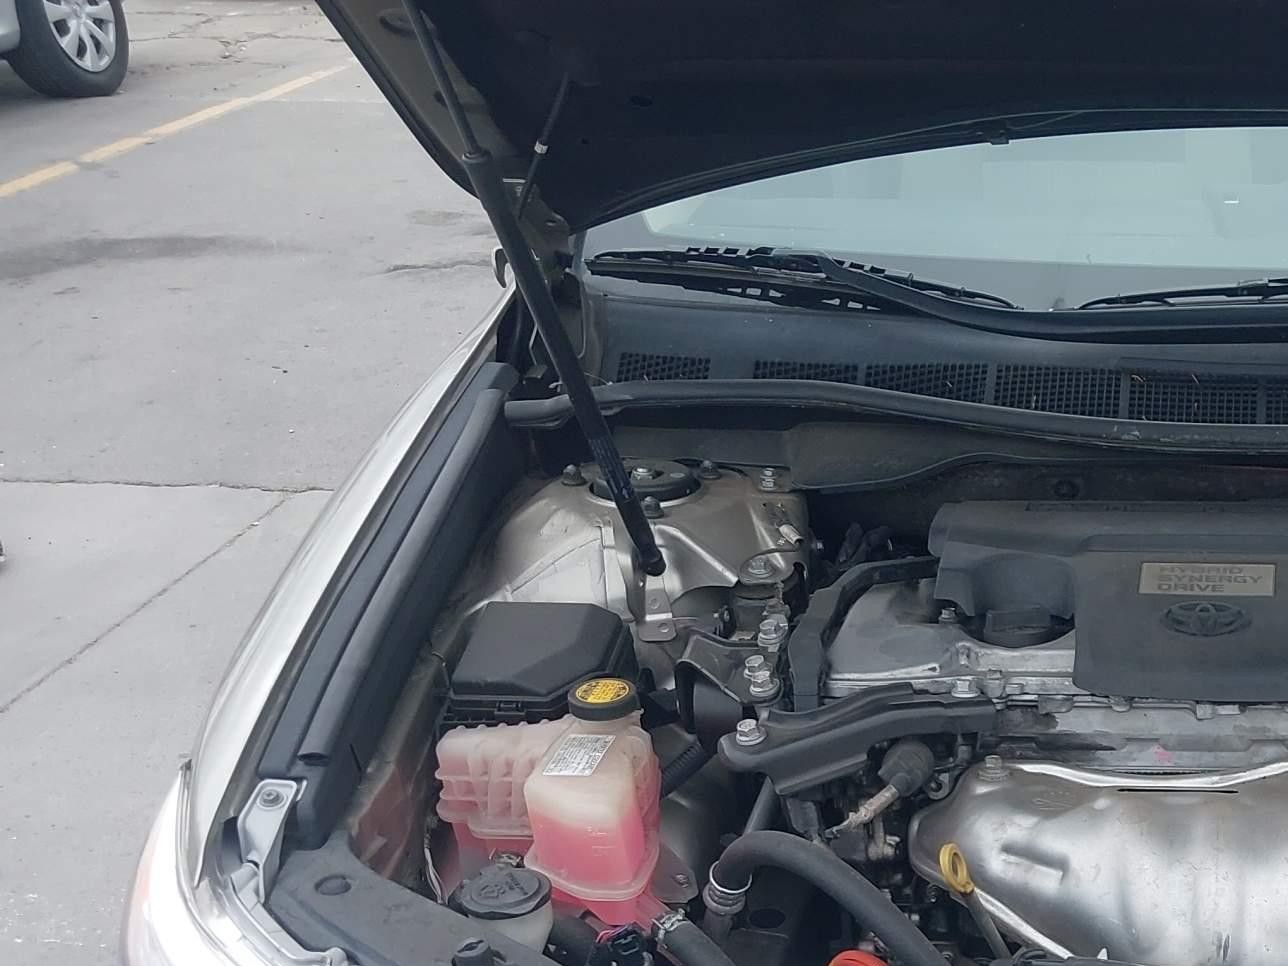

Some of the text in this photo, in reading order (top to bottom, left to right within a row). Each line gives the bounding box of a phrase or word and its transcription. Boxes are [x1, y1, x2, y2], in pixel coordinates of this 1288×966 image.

[1159, 566, 1244, 574] HYBRID
[1157, 574, 1263, 584] SYNERGY
[1157, 583, 1225, 592] DRIVE
